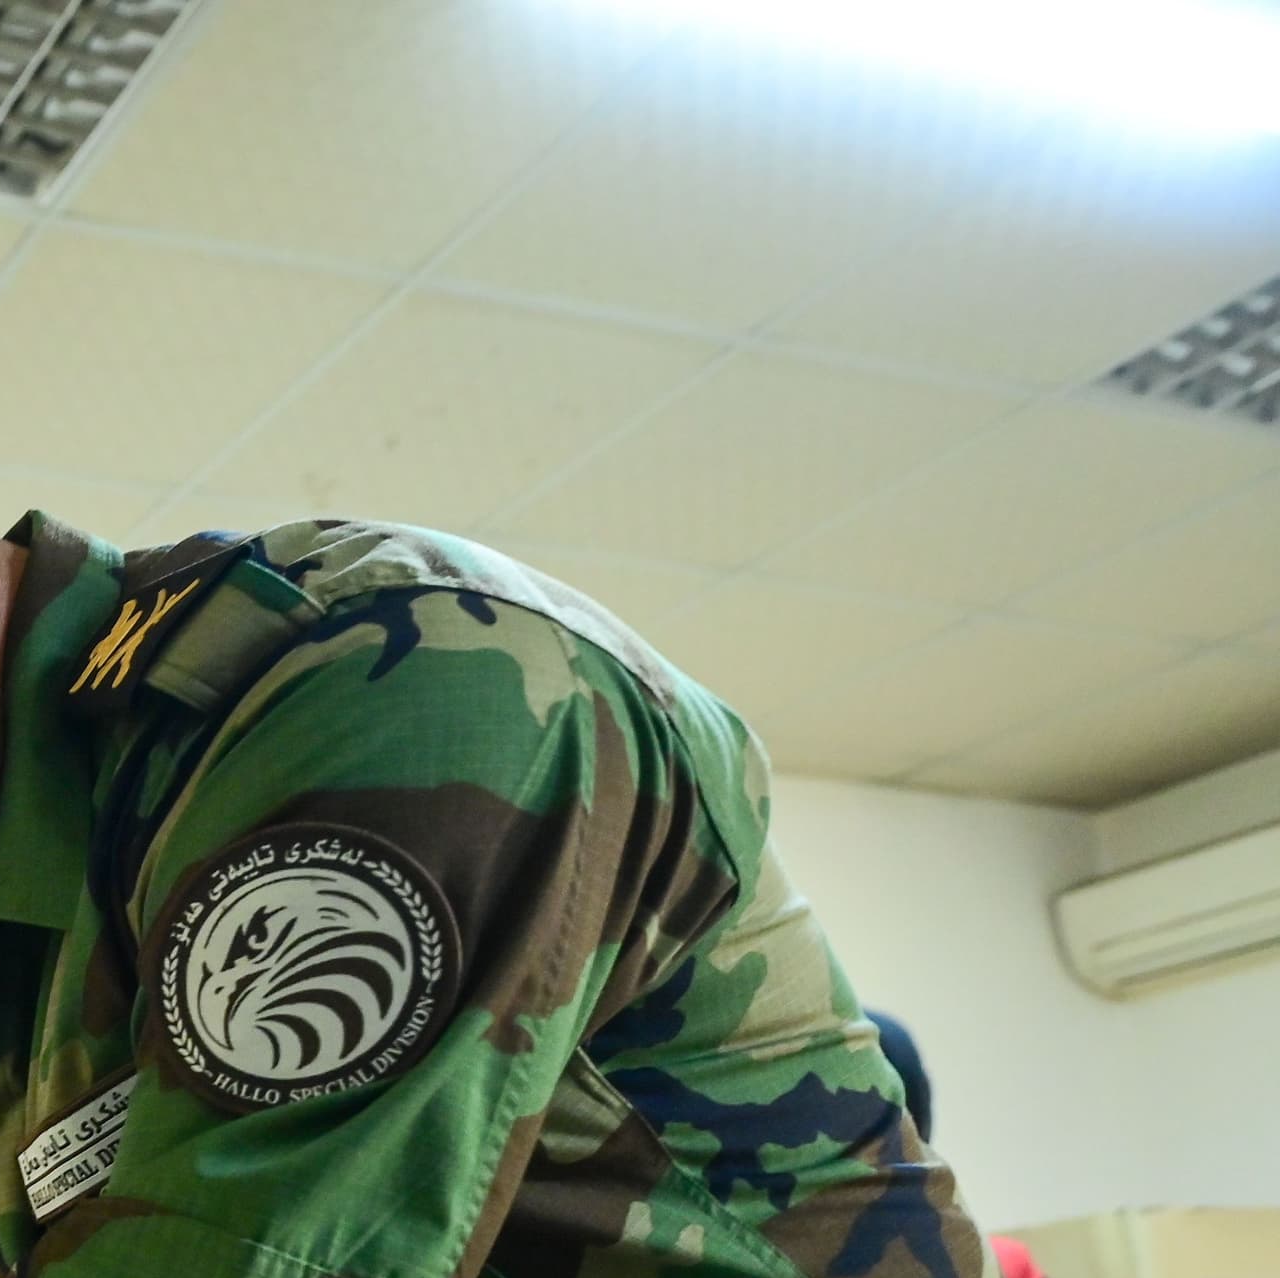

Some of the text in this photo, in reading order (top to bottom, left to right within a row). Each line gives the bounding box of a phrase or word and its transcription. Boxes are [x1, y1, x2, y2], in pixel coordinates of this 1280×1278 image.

[211, 996, 435, 1105] HALLO SPECIAL DIVISION
